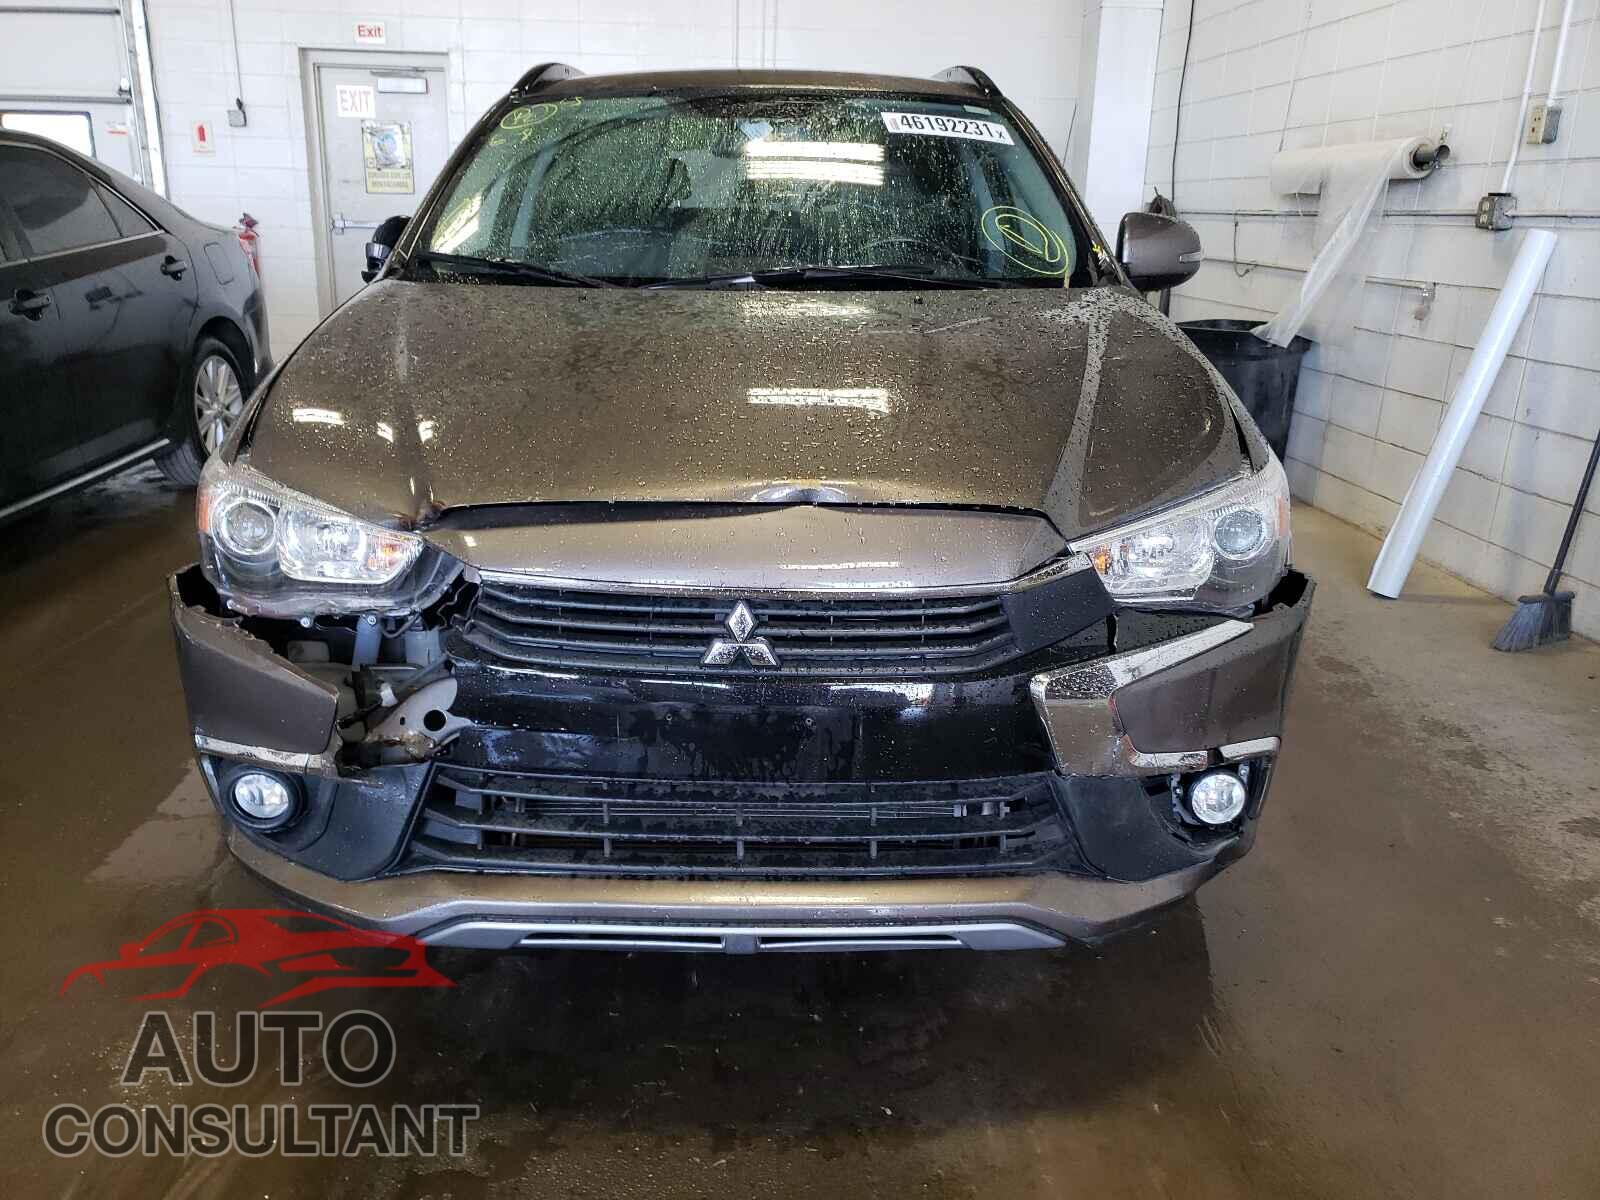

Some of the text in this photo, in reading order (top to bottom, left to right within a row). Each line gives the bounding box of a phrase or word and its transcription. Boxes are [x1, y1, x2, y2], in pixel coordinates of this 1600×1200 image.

[357, 24, 382, 38] Exit
[339, 89, 372, 113] EXIT
[900, 115, 994, 138] 46192231
